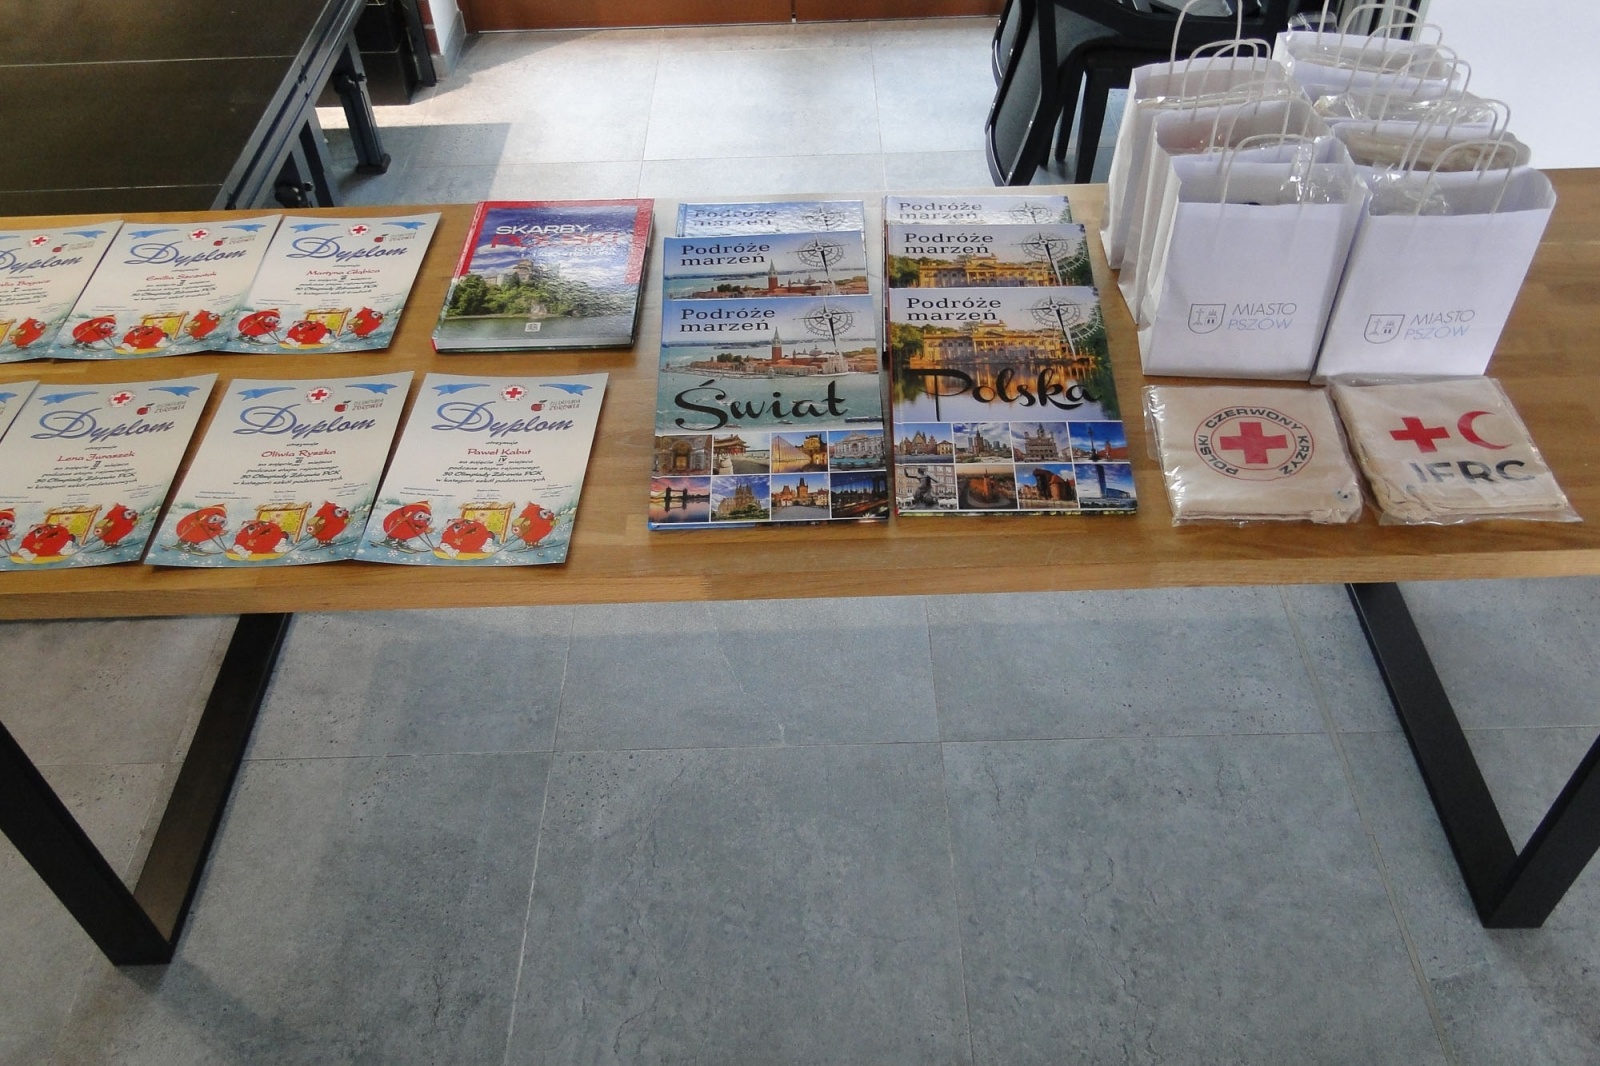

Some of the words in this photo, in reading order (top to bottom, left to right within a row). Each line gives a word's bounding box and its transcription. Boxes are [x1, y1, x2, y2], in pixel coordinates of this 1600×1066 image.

[899, 202, 982, 210] Podróże
[496, 224, 591, 235] SKARBY
[904, 233, 993, 243] Podróże
[124, 241, 247, 266] Dyplom
[286, 236, 408, 262] Dyplom
[682, 243, 770, 255] Podróże
[905, 244, 989, 254] marzeń
[681, 253, 766, 266] marzeń
[906, 297, 1002, 309] Podróże
[1232, 303, 1297, 315] MIASTO
[681, 307, 775, 320] Podróże
[907, 309, 998, 321] marzeń
[1410, 310, 1475, 325] MIASTO
[680, 320, 770, 333] marzeń
[909, 368, 1102, 422] Polska
[674, 379, 848, 431] Świat
[31, 408, 175, 443] Dyplom
[233, 404, 376, 439] Dyplom
[431, 401, 574, 437] Dyplom
[1205, 408, 1302, 430] CZERWONY
[299, 449, 336, 457] Ryszka
[1198, 435, 1239, 475] POLSKI
[1409, 460, 1536, 484] IFRC
